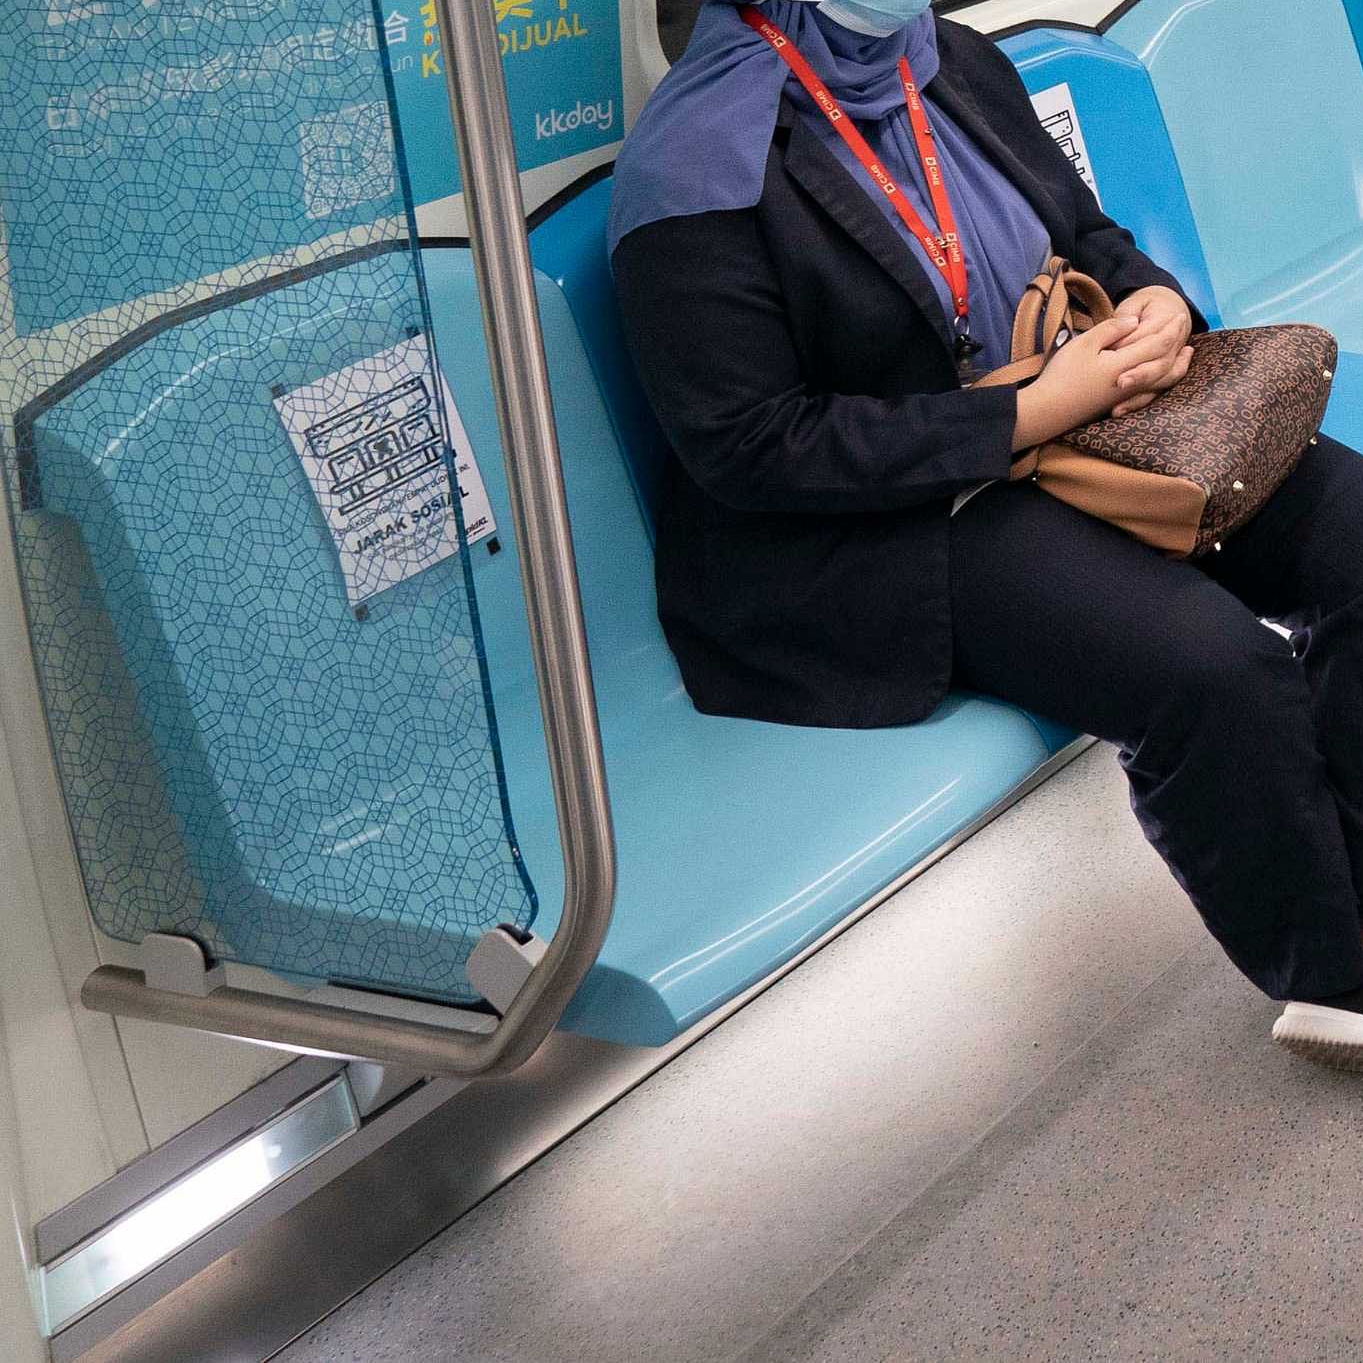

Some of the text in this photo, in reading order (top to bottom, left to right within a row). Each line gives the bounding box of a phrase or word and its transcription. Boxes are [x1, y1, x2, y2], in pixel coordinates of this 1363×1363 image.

[535, 99, 614, 141] kkday
[353, 515, 408, 555] JARAK
[411, 485, 470, 525] SOSIL
